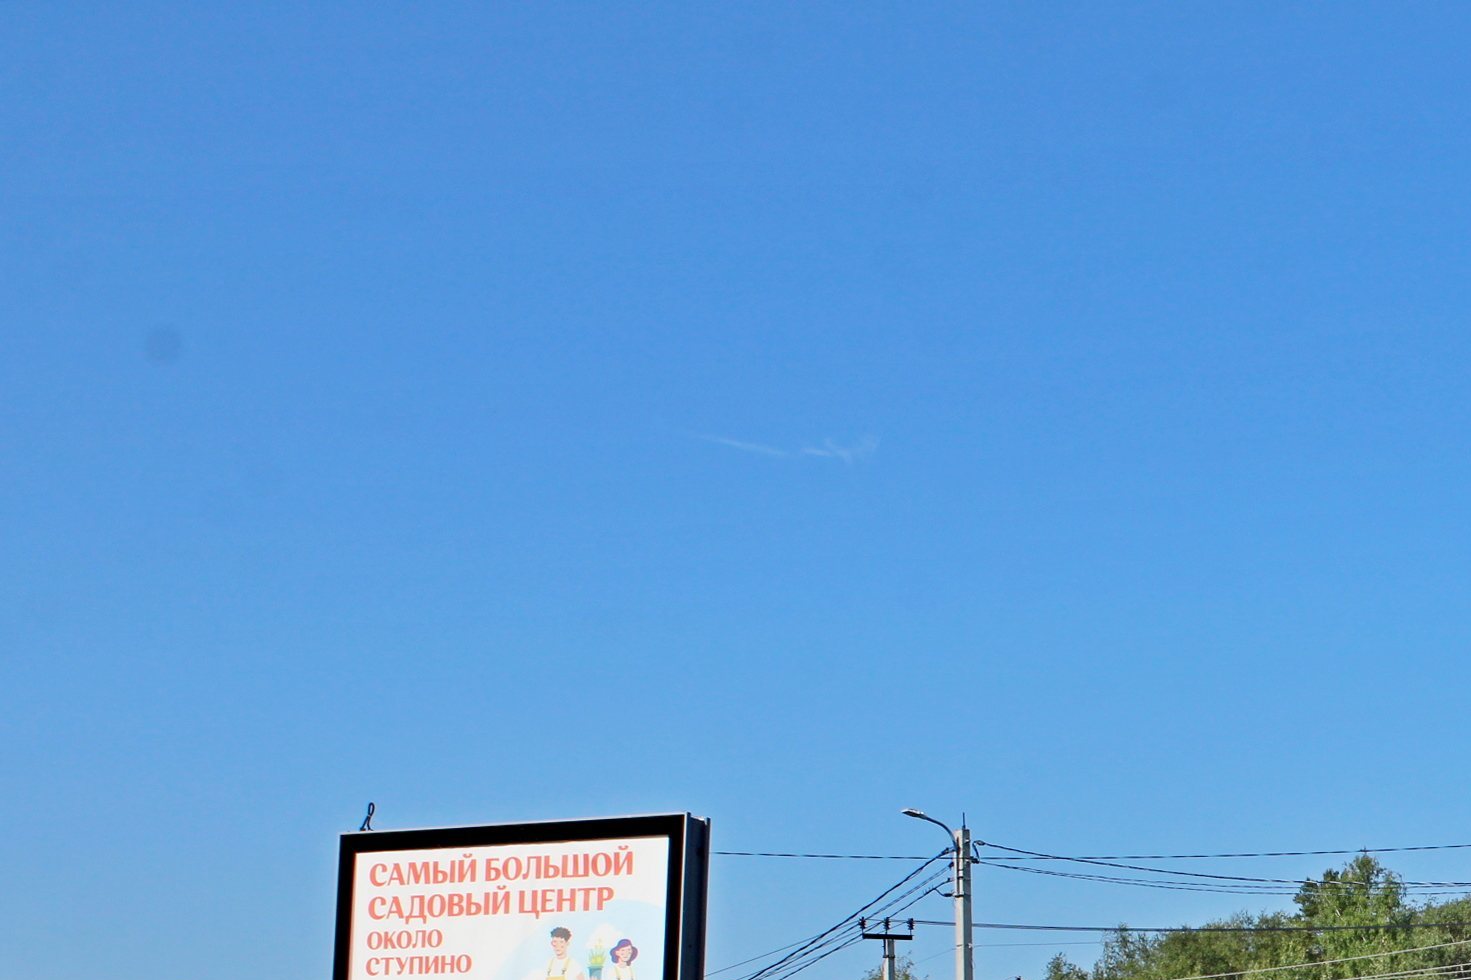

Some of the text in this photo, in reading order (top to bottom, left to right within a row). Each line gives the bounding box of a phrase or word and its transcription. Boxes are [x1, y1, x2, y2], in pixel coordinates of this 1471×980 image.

[369, 845, 634, 887] САМЫЙ БОЛЬШОЙ
[367, 885, 615, 924] САДОВЫЙ ЦЕНТР
[366, 928, 443, 951] ОКОЛО
[365, 953, 473, 977] СТУПИНО
